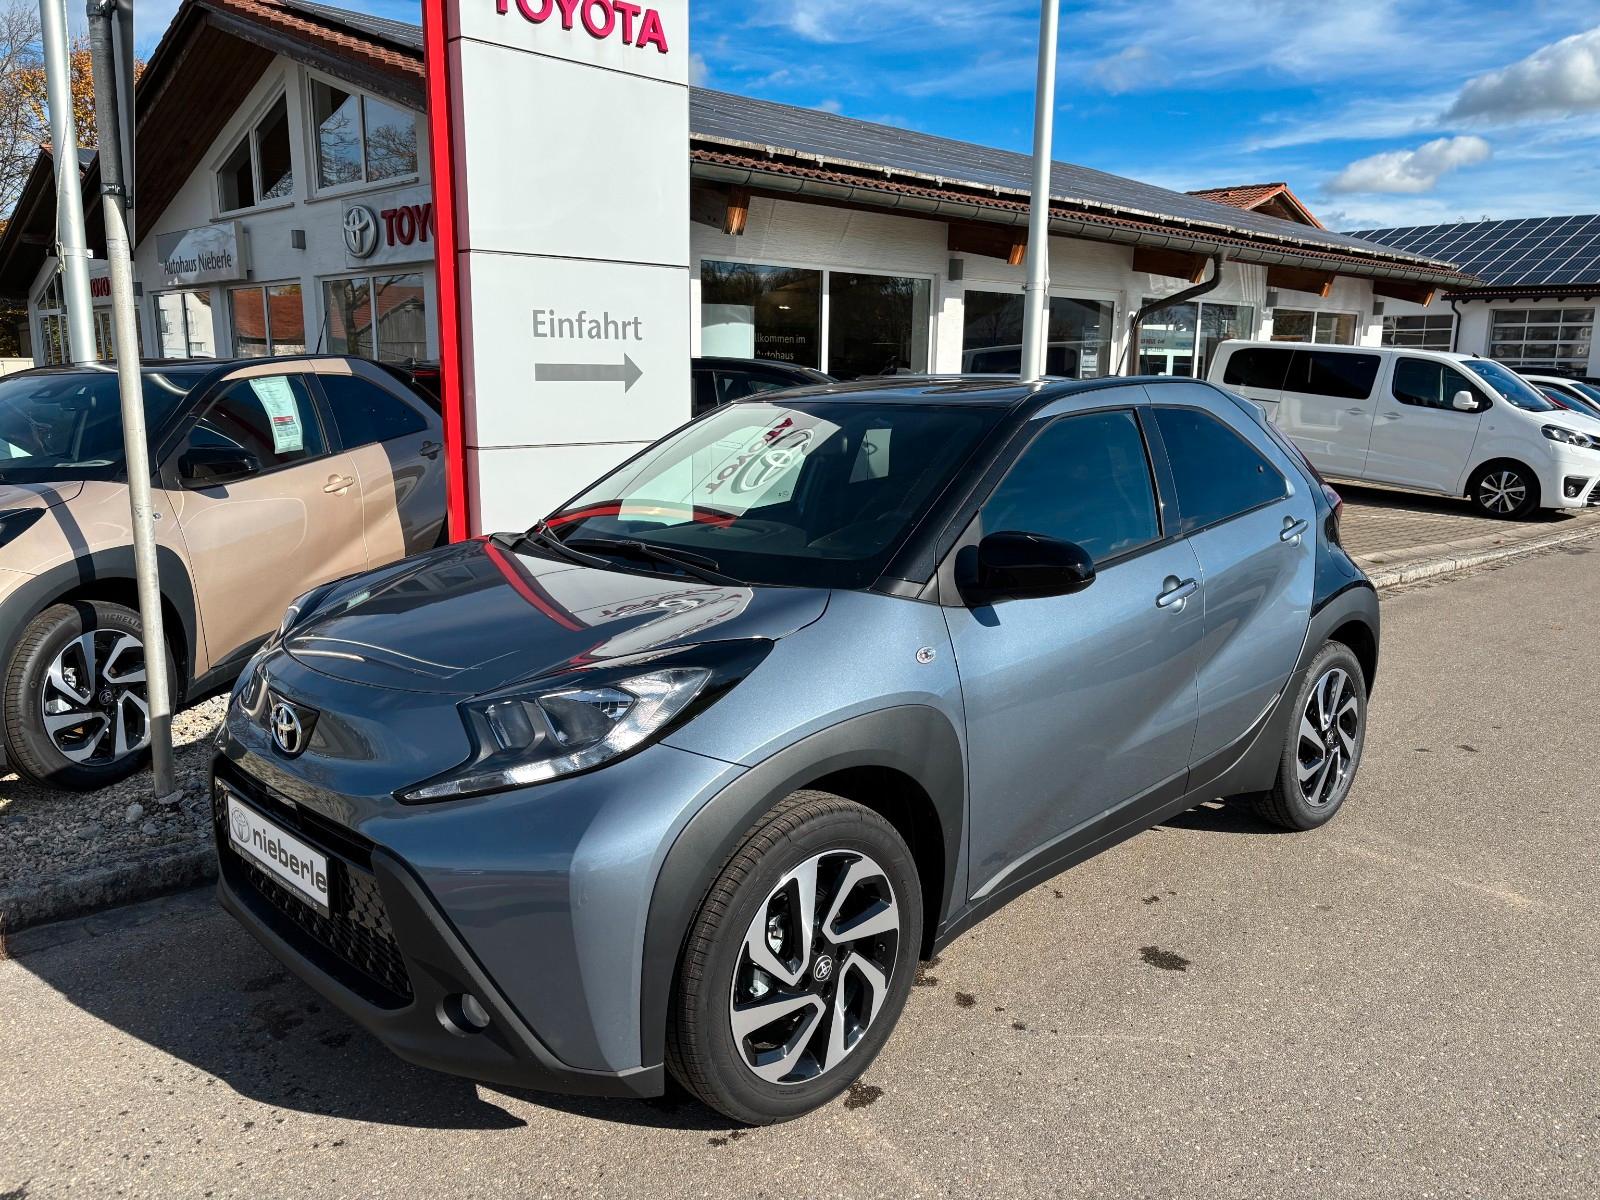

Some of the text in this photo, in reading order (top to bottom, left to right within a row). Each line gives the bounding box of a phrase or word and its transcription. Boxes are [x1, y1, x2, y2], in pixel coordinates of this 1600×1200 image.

[380, 203, 433, 246] TOY
[164, 249, 232, 275] Autohaus Nieberle
[532, 309, 643, 341] Einfahrt
[795, 333, 806, 344] im
[253, 828, 327, 893] nieberle
